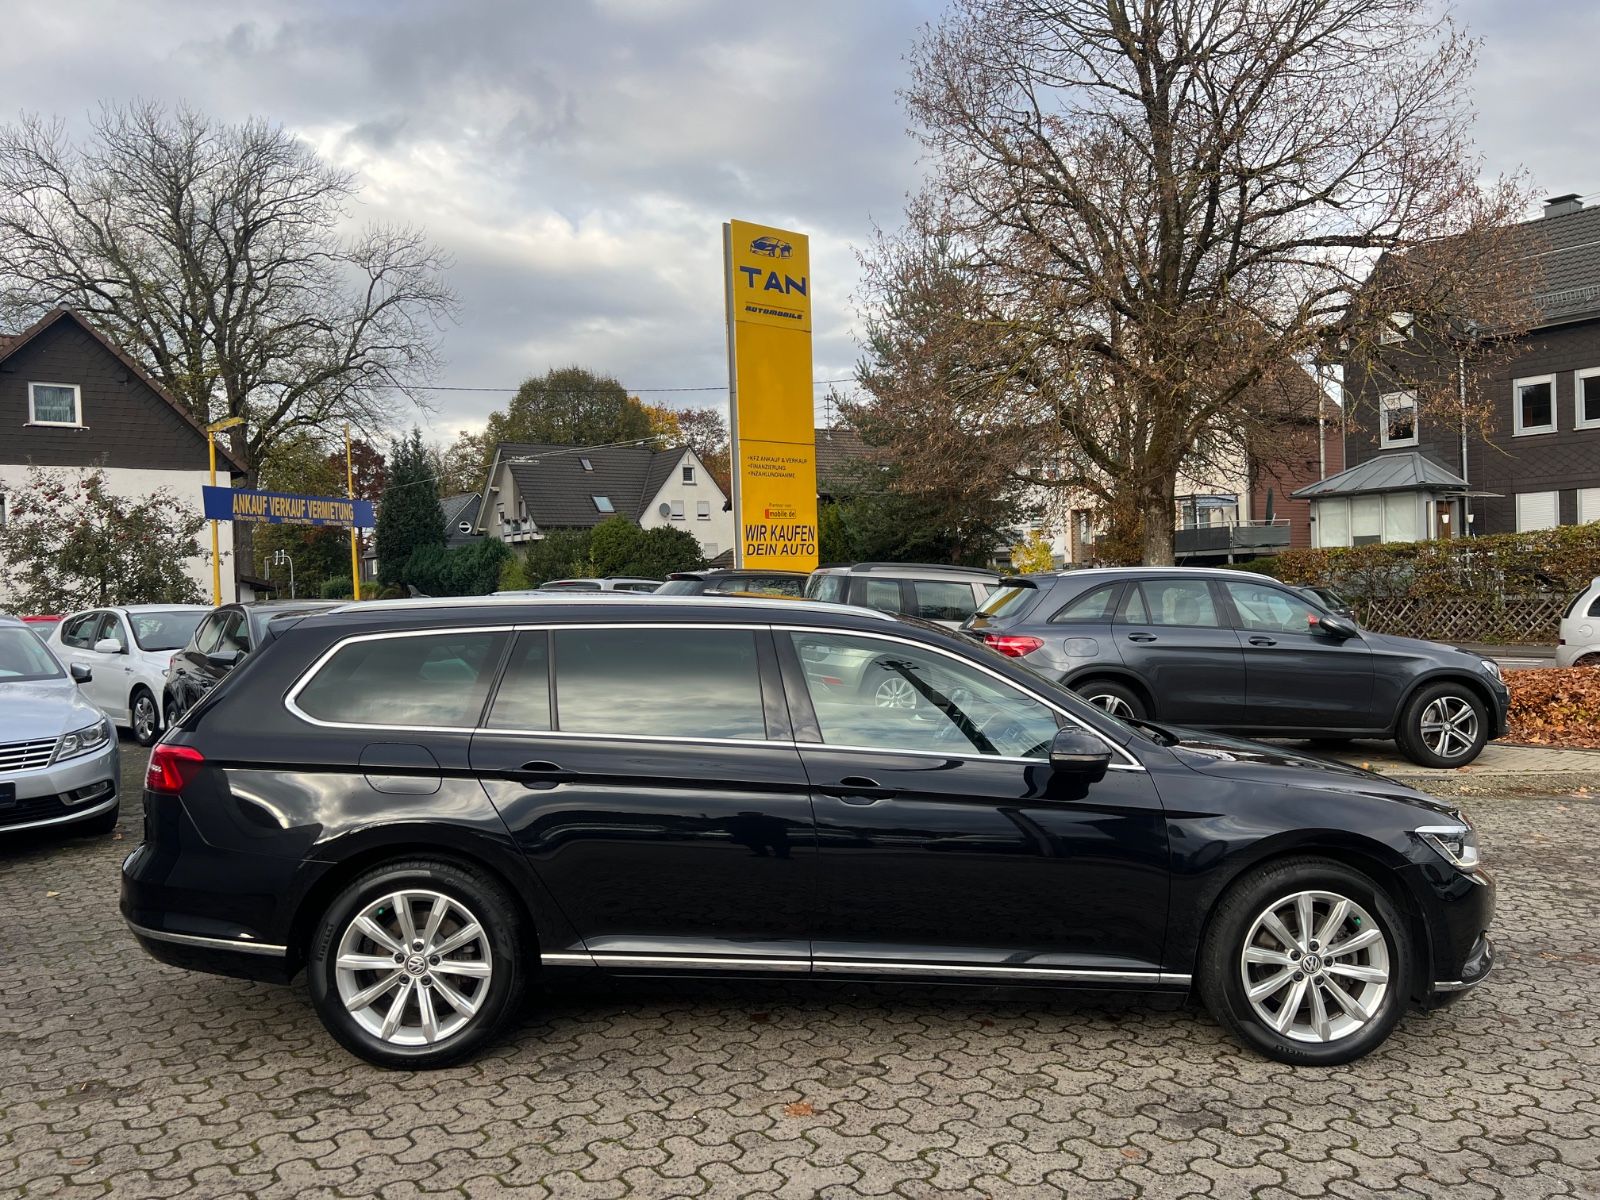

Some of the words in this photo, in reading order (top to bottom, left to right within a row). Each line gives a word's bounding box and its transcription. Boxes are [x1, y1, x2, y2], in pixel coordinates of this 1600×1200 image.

[740, 266, 806, 296] TAN
[745, 306, 802, 319] AUTOMOBILE
[233, 494, 268, 514] ANKAUF
[269, 497, 306, 517] VERKAUF
[307, 501, 353, 520] VERMIETUNG
[745, 524, 767, 542] WIR
[770, 525, 815, 542] KAUFEN
[746, 543, 778, 556] DEIN
[780, 543, 815, 556] AUTO
